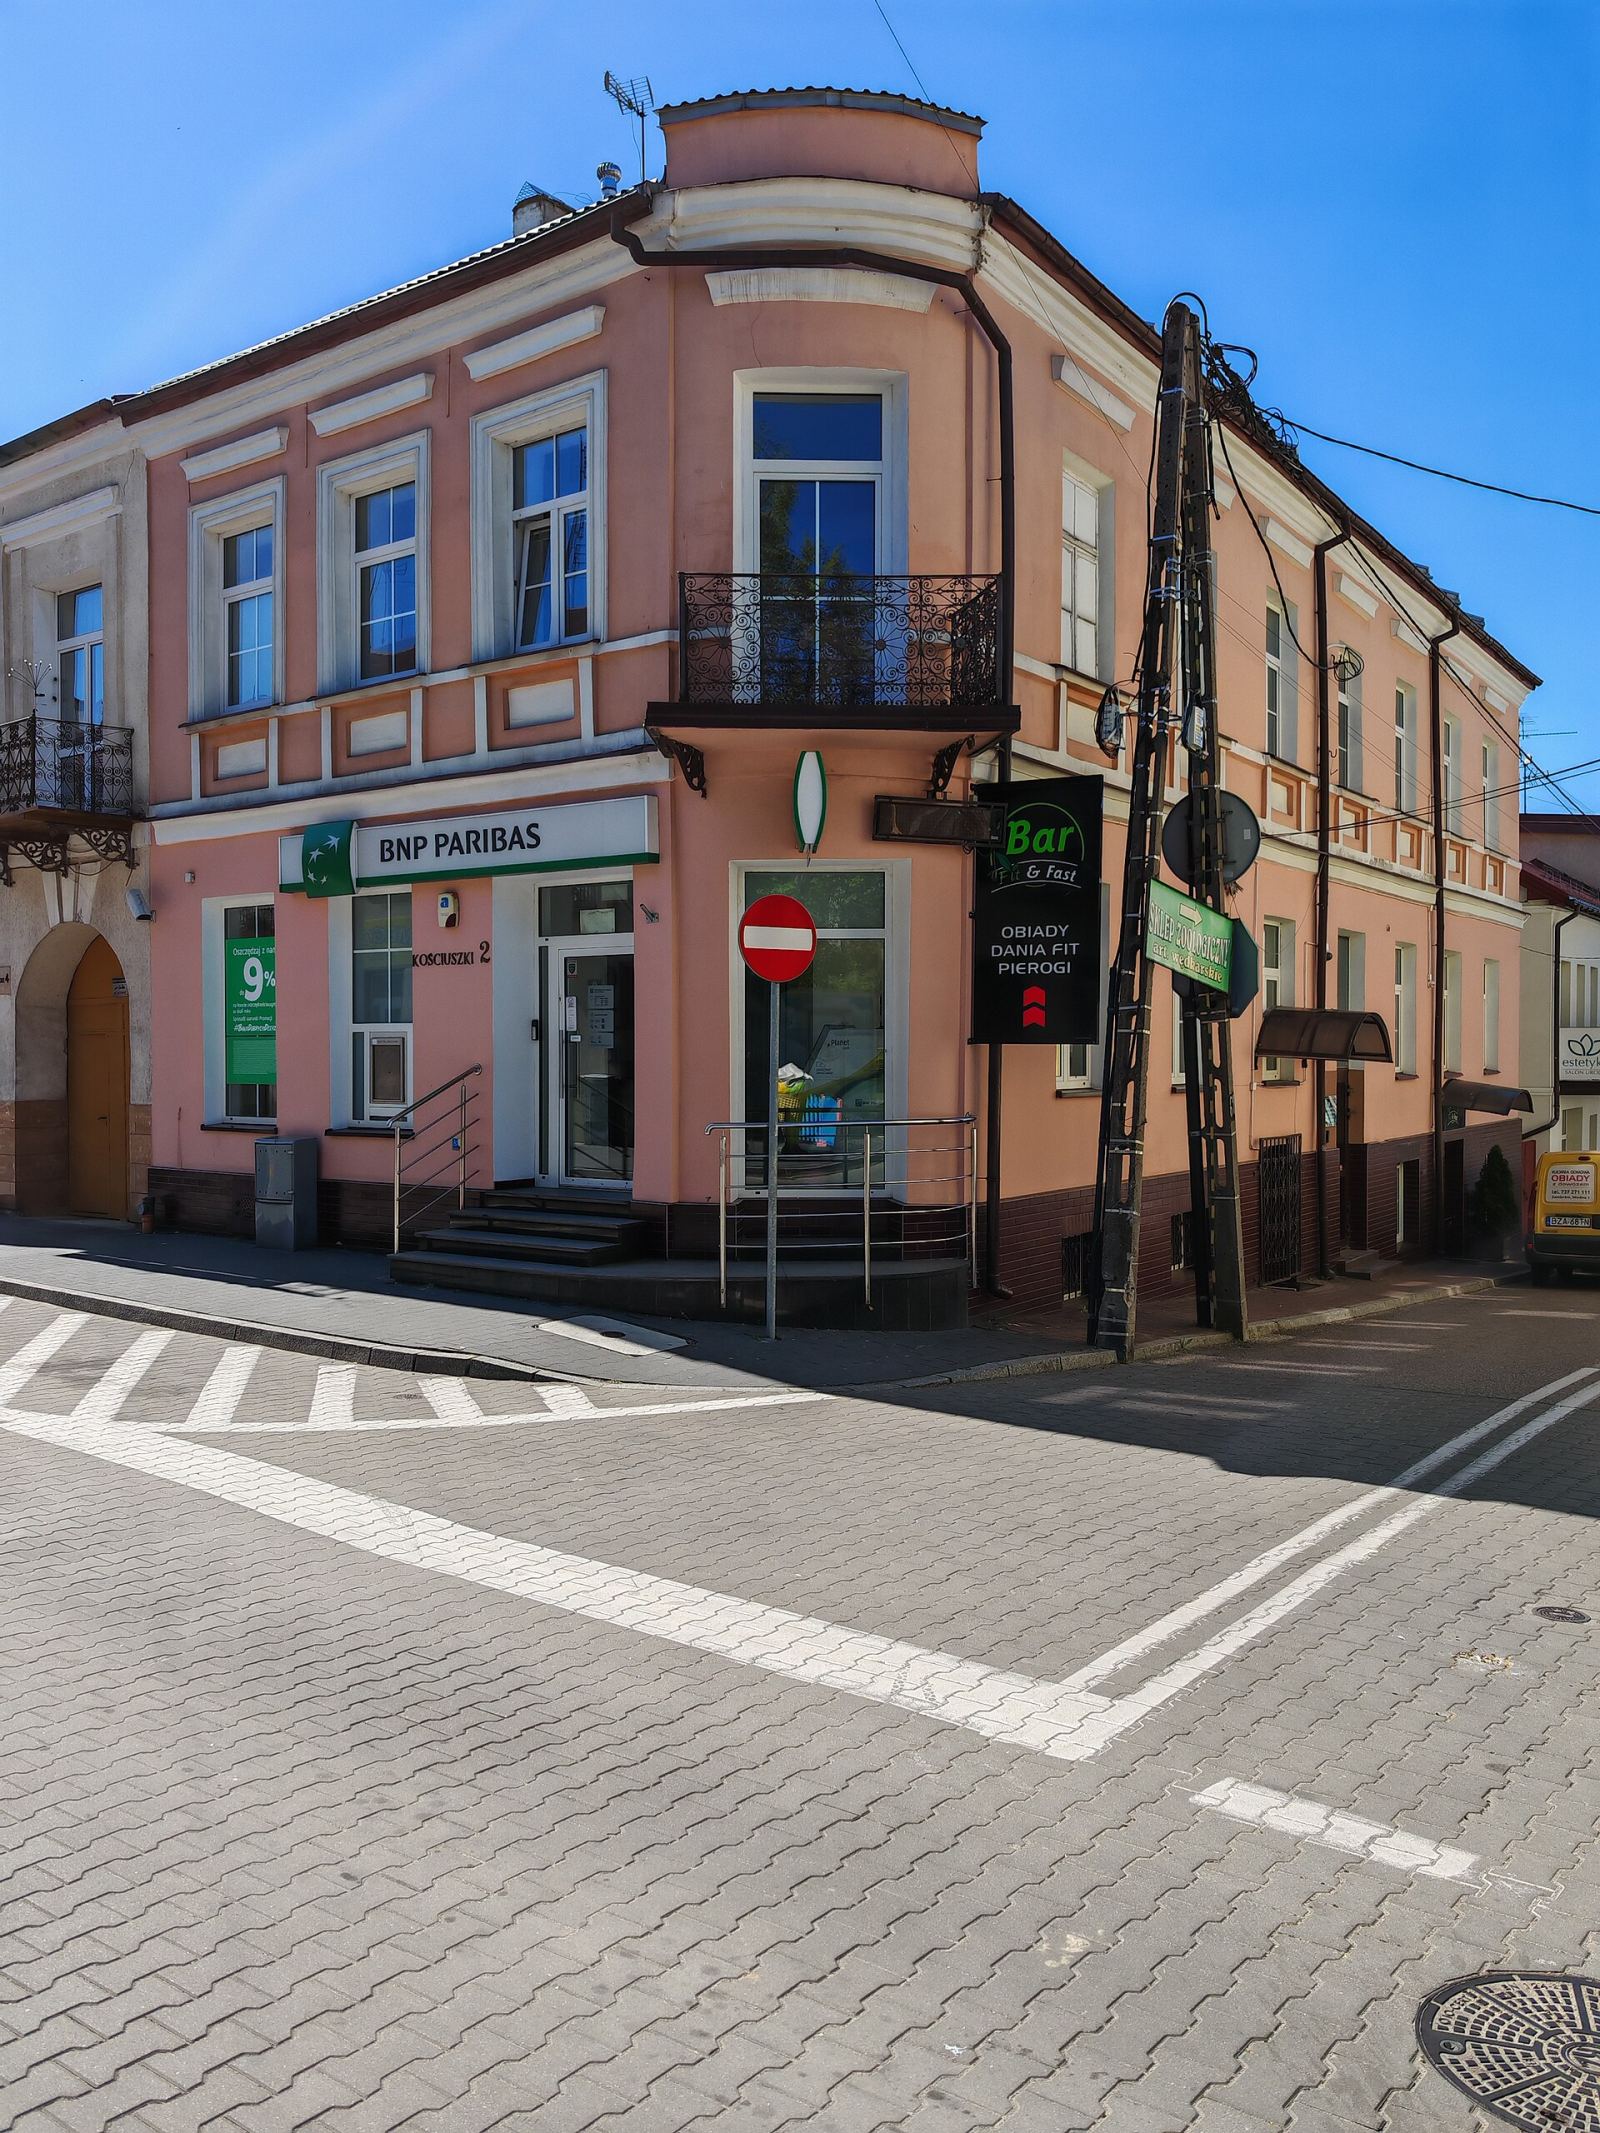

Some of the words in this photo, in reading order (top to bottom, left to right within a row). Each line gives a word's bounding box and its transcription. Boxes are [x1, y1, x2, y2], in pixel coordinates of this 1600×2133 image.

[380, 836, 428, 862] BNP
[434, 823, 541, 857] PARIBAS
[1006, 819, 1075, 855] Bar
[1027, 865, 1041, 879] &
[1046, 865, 1077, 882] Fast
[1001, 925, 1069, 939] OBIADY
[1148, 902, 1175, 943] SKLEP
[1176, 921, 1231, 969] ZOOLOGICZNY
[479, 940, 491, 963] 2
[991, 944, 1047, 957] DANIA
[1052, 942, 1080, 956] FIT
[998, 961, 1071, 975] PIEROGI
[1172, 951, 1223, 983] wędkarskie
[1551, 1174, 1590, 1182] OBIADY
